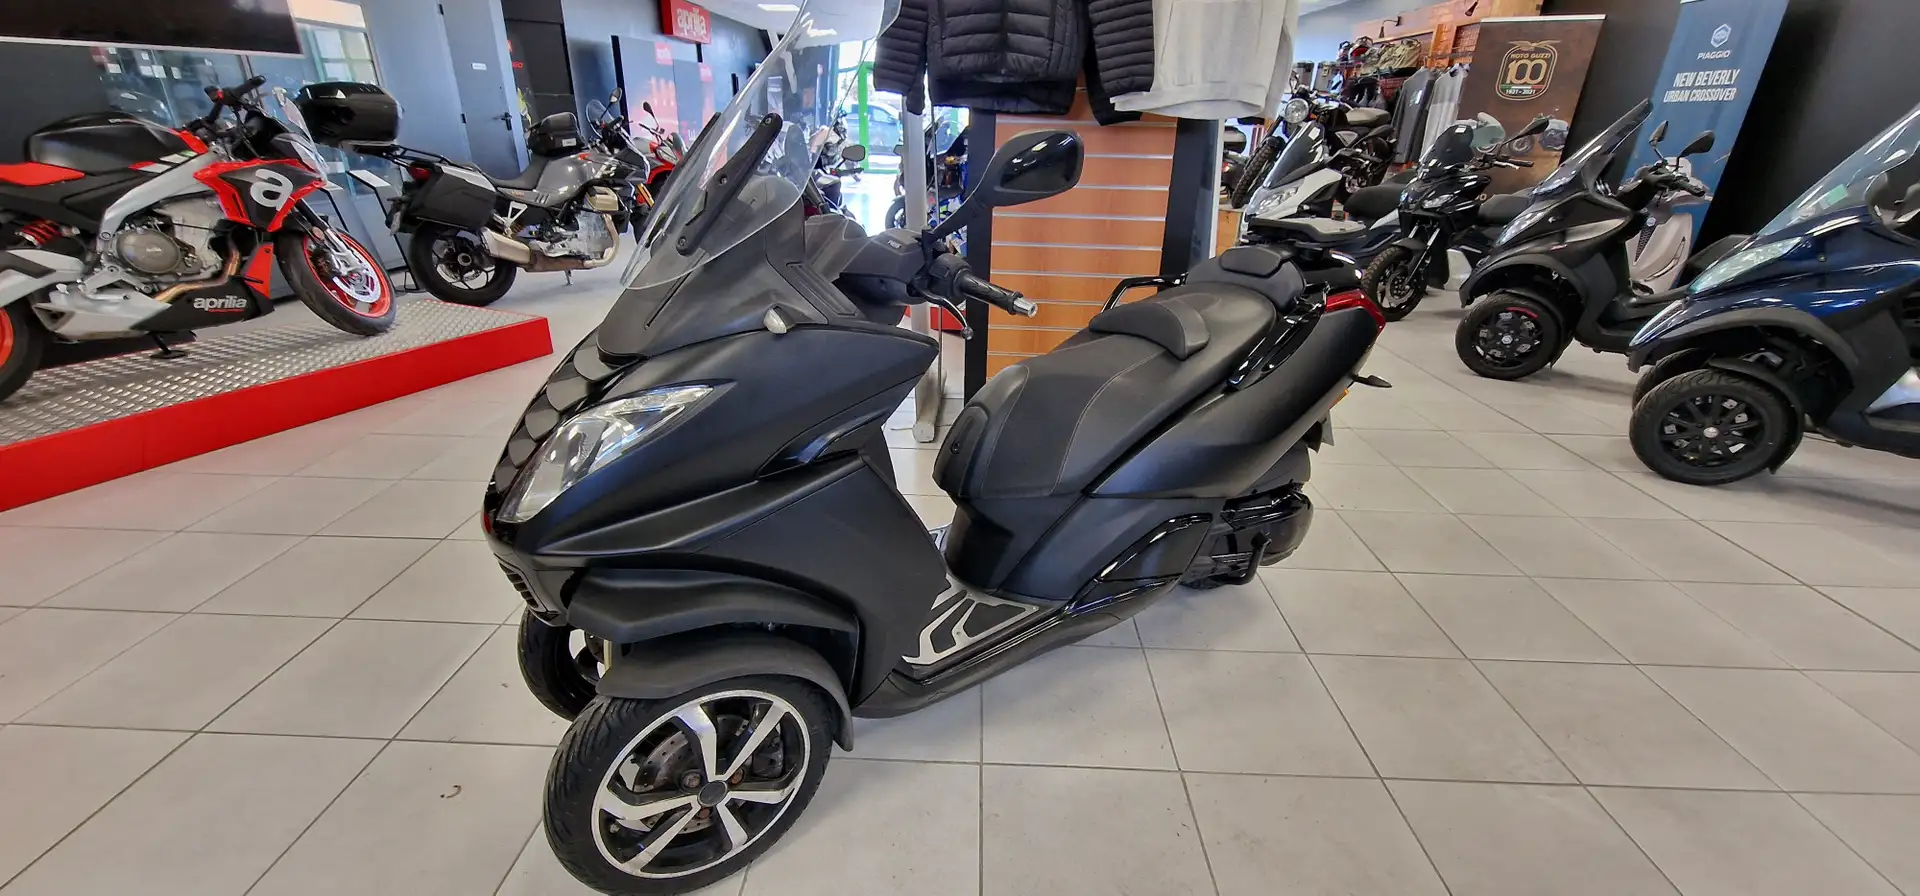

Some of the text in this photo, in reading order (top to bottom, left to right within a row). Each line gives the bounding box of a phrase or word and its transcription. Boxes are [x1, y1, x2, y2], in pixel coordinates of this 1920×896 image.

[676, 7, 707, 37] aprilia
[1697, 50, 1731, 60] PIAGGIO
[1506, 59, 1548, 85] 100
[1673, 69, 1740, 88] NEW BEVERLY
[1663, 88, 1737, 103] URBAN CROSSOVER
[193, 295, 248, 312] aprilia
